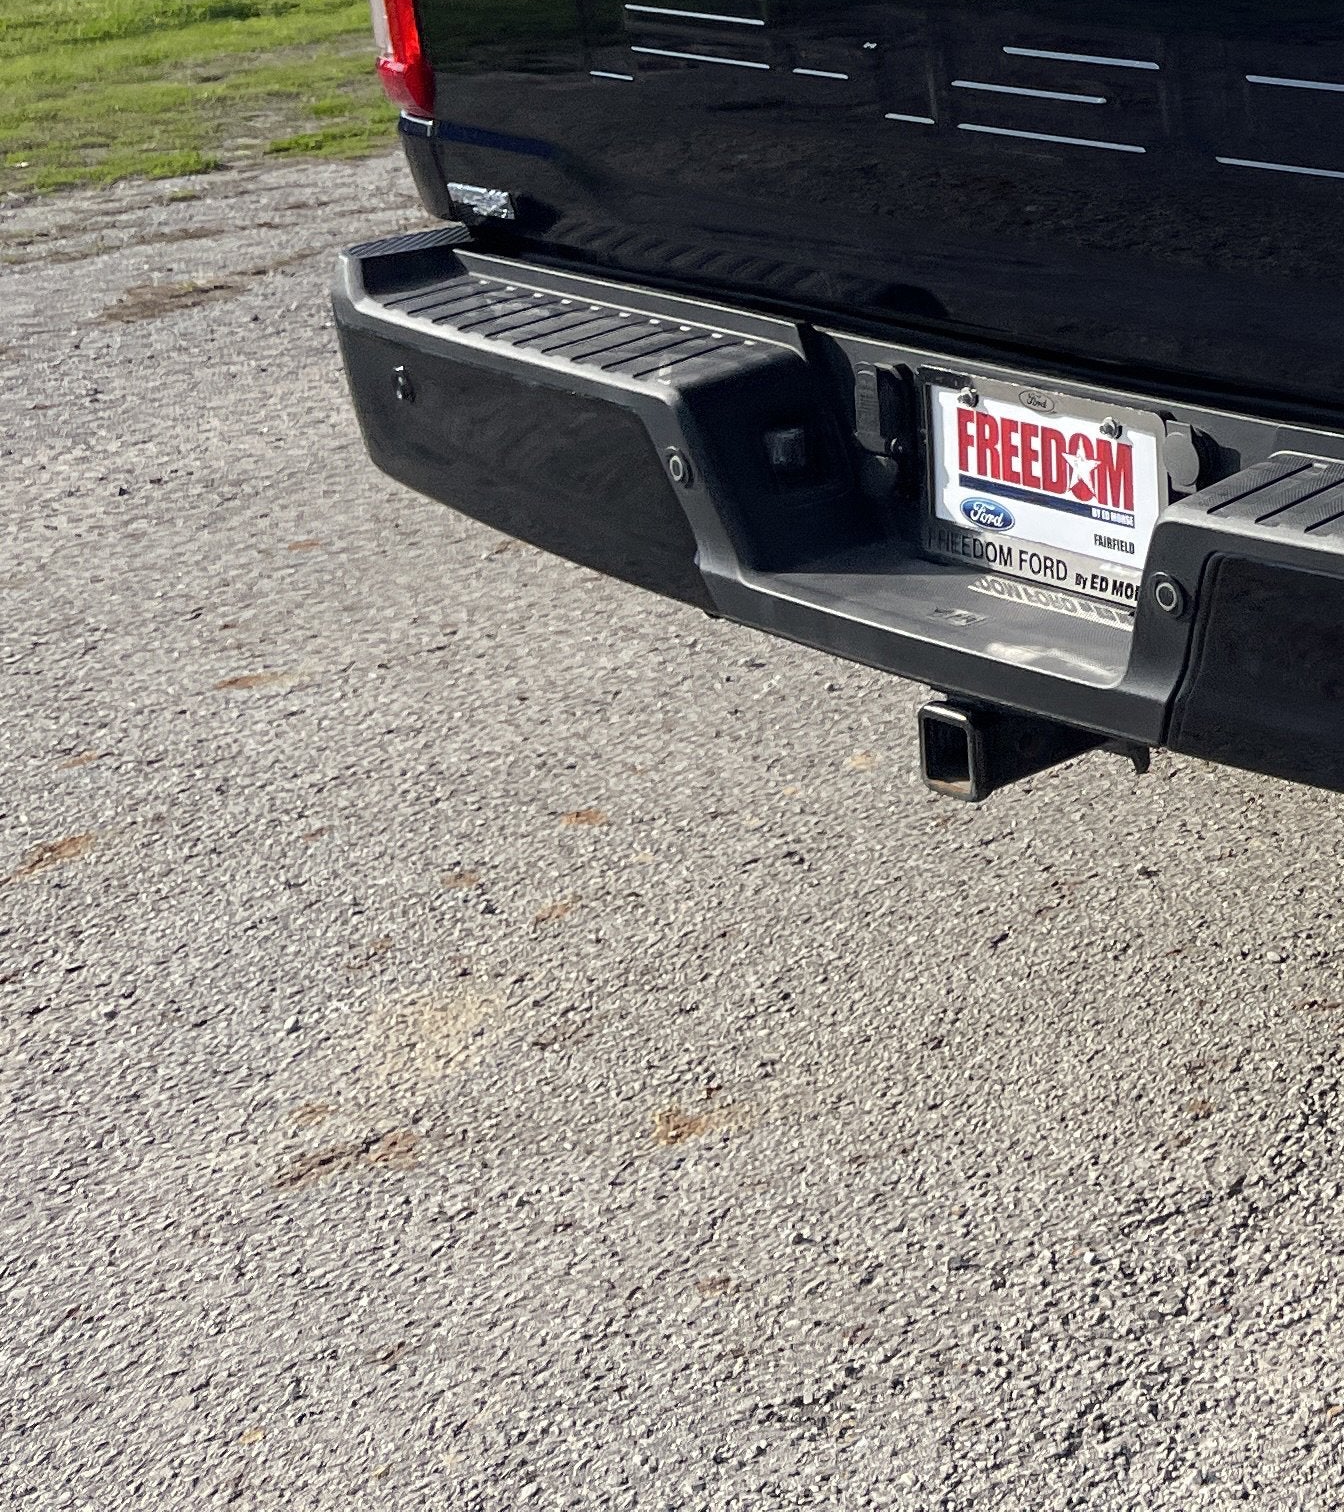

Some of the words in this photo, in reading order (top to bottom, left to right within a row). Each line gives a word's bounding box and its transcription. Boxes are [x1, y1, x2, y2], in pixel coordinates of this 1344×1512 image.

[957, 407, 1134, 511] FREEDOM
[1094, 534, 1135, 554] FAIRFIELD
[1018, 552, 1068, 581] FORD
[1090, 573, 1109, 592] ED
